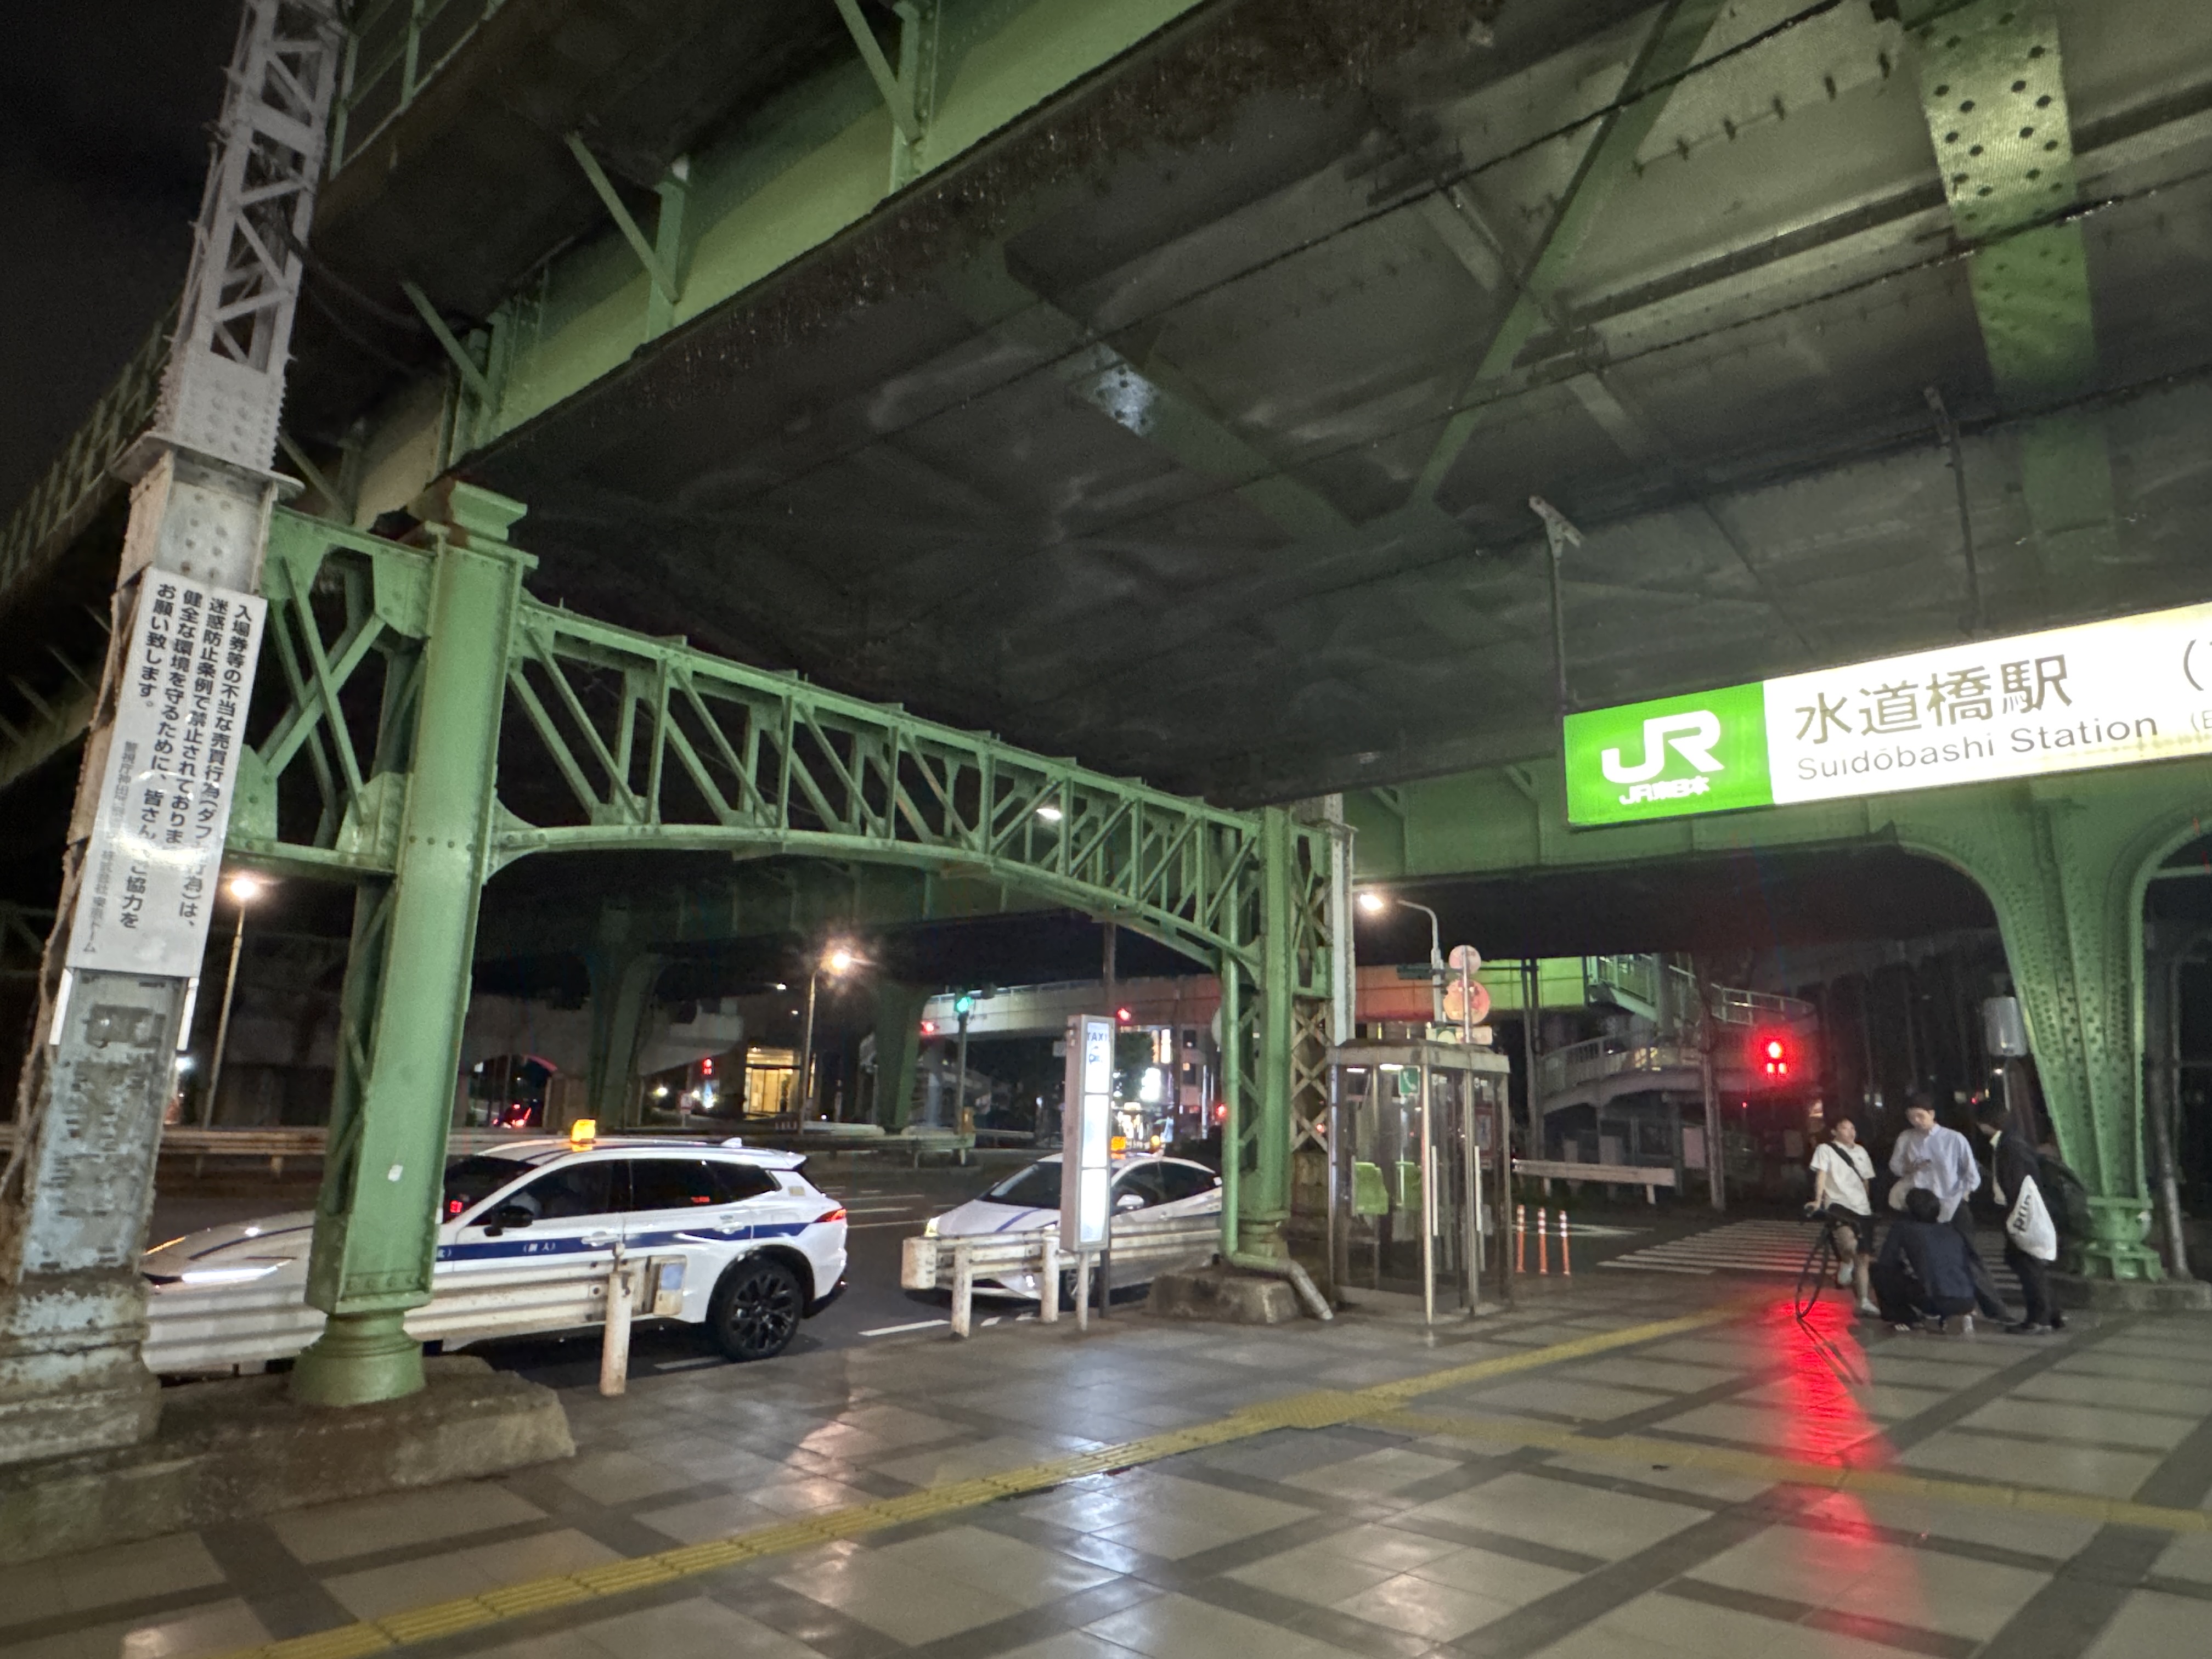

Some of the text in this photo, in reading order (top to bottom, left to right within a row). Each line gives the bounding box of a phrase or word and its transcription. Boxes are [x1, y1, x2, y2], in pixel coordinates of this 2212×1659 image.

[138, 584, 176, 707] お願い致します。
[1795, 654, 2073, 744] 水道橋駅
[2010, 716, 2158, 753] Station
[1601, 710, 1725, 783] JR
